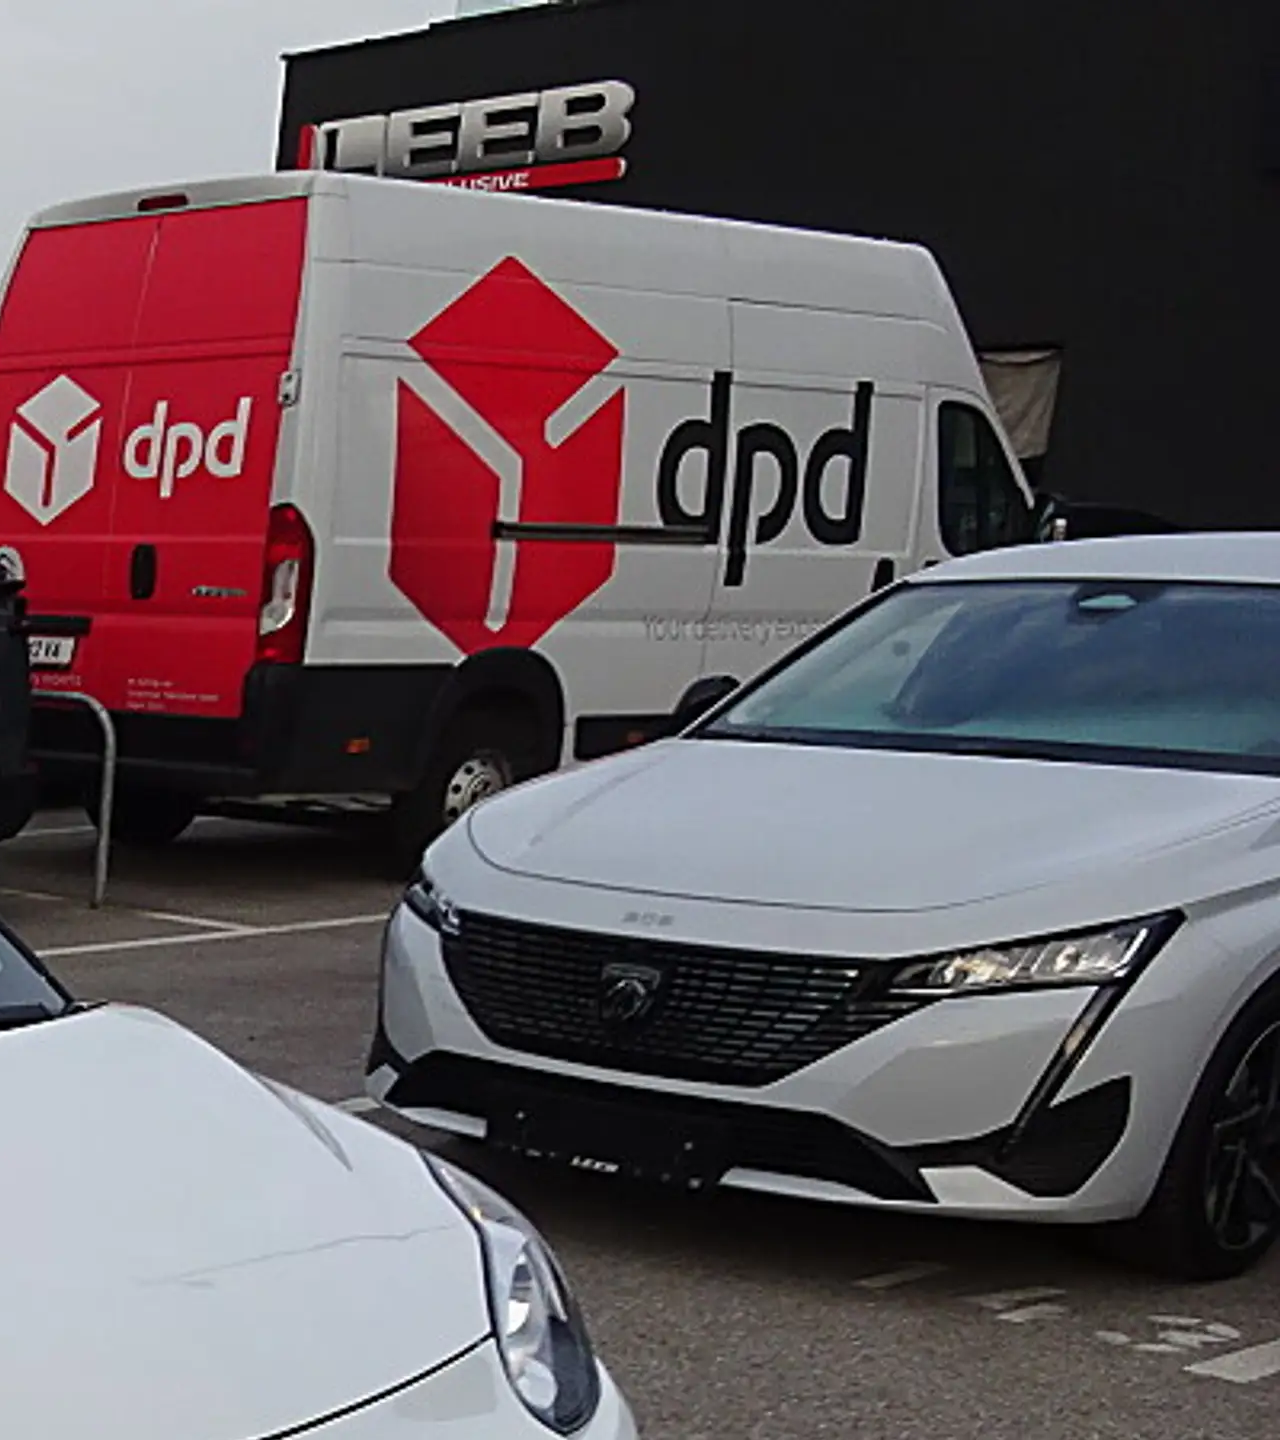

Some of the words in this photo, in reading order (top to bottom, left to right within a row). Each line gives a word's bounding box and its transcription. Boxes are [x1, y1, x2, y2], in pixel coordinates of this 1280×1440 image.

[317, 79, 636, 178] LEEB
[123, 396, 253, 499] dpd
[656, 370, 874, 587] dpd
